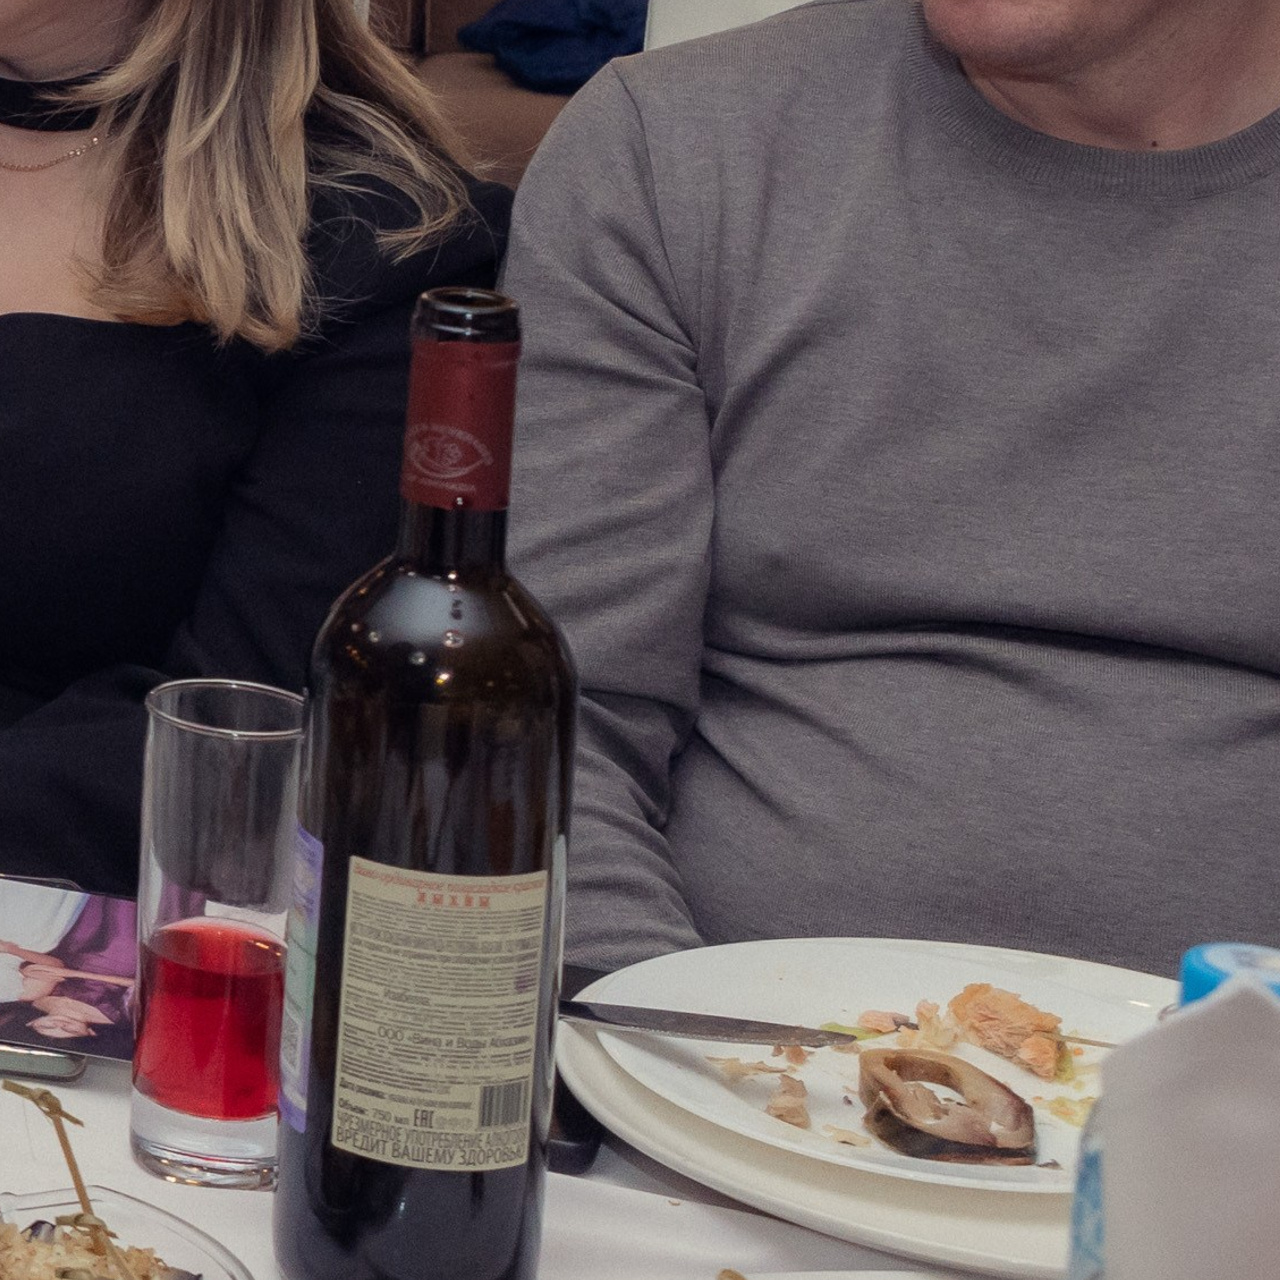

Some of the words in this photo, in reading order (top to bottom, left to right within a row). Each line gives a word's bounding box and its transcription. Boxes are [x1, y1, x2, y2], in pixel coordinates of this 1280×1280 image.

[336, 1112, 403, 1144] ЧРЕЗМЕРНОЕ
[336, 1125, 388, 1156] ВРЕДИТ
[391, 1140, 456, 1165] ВАШЕМУ
